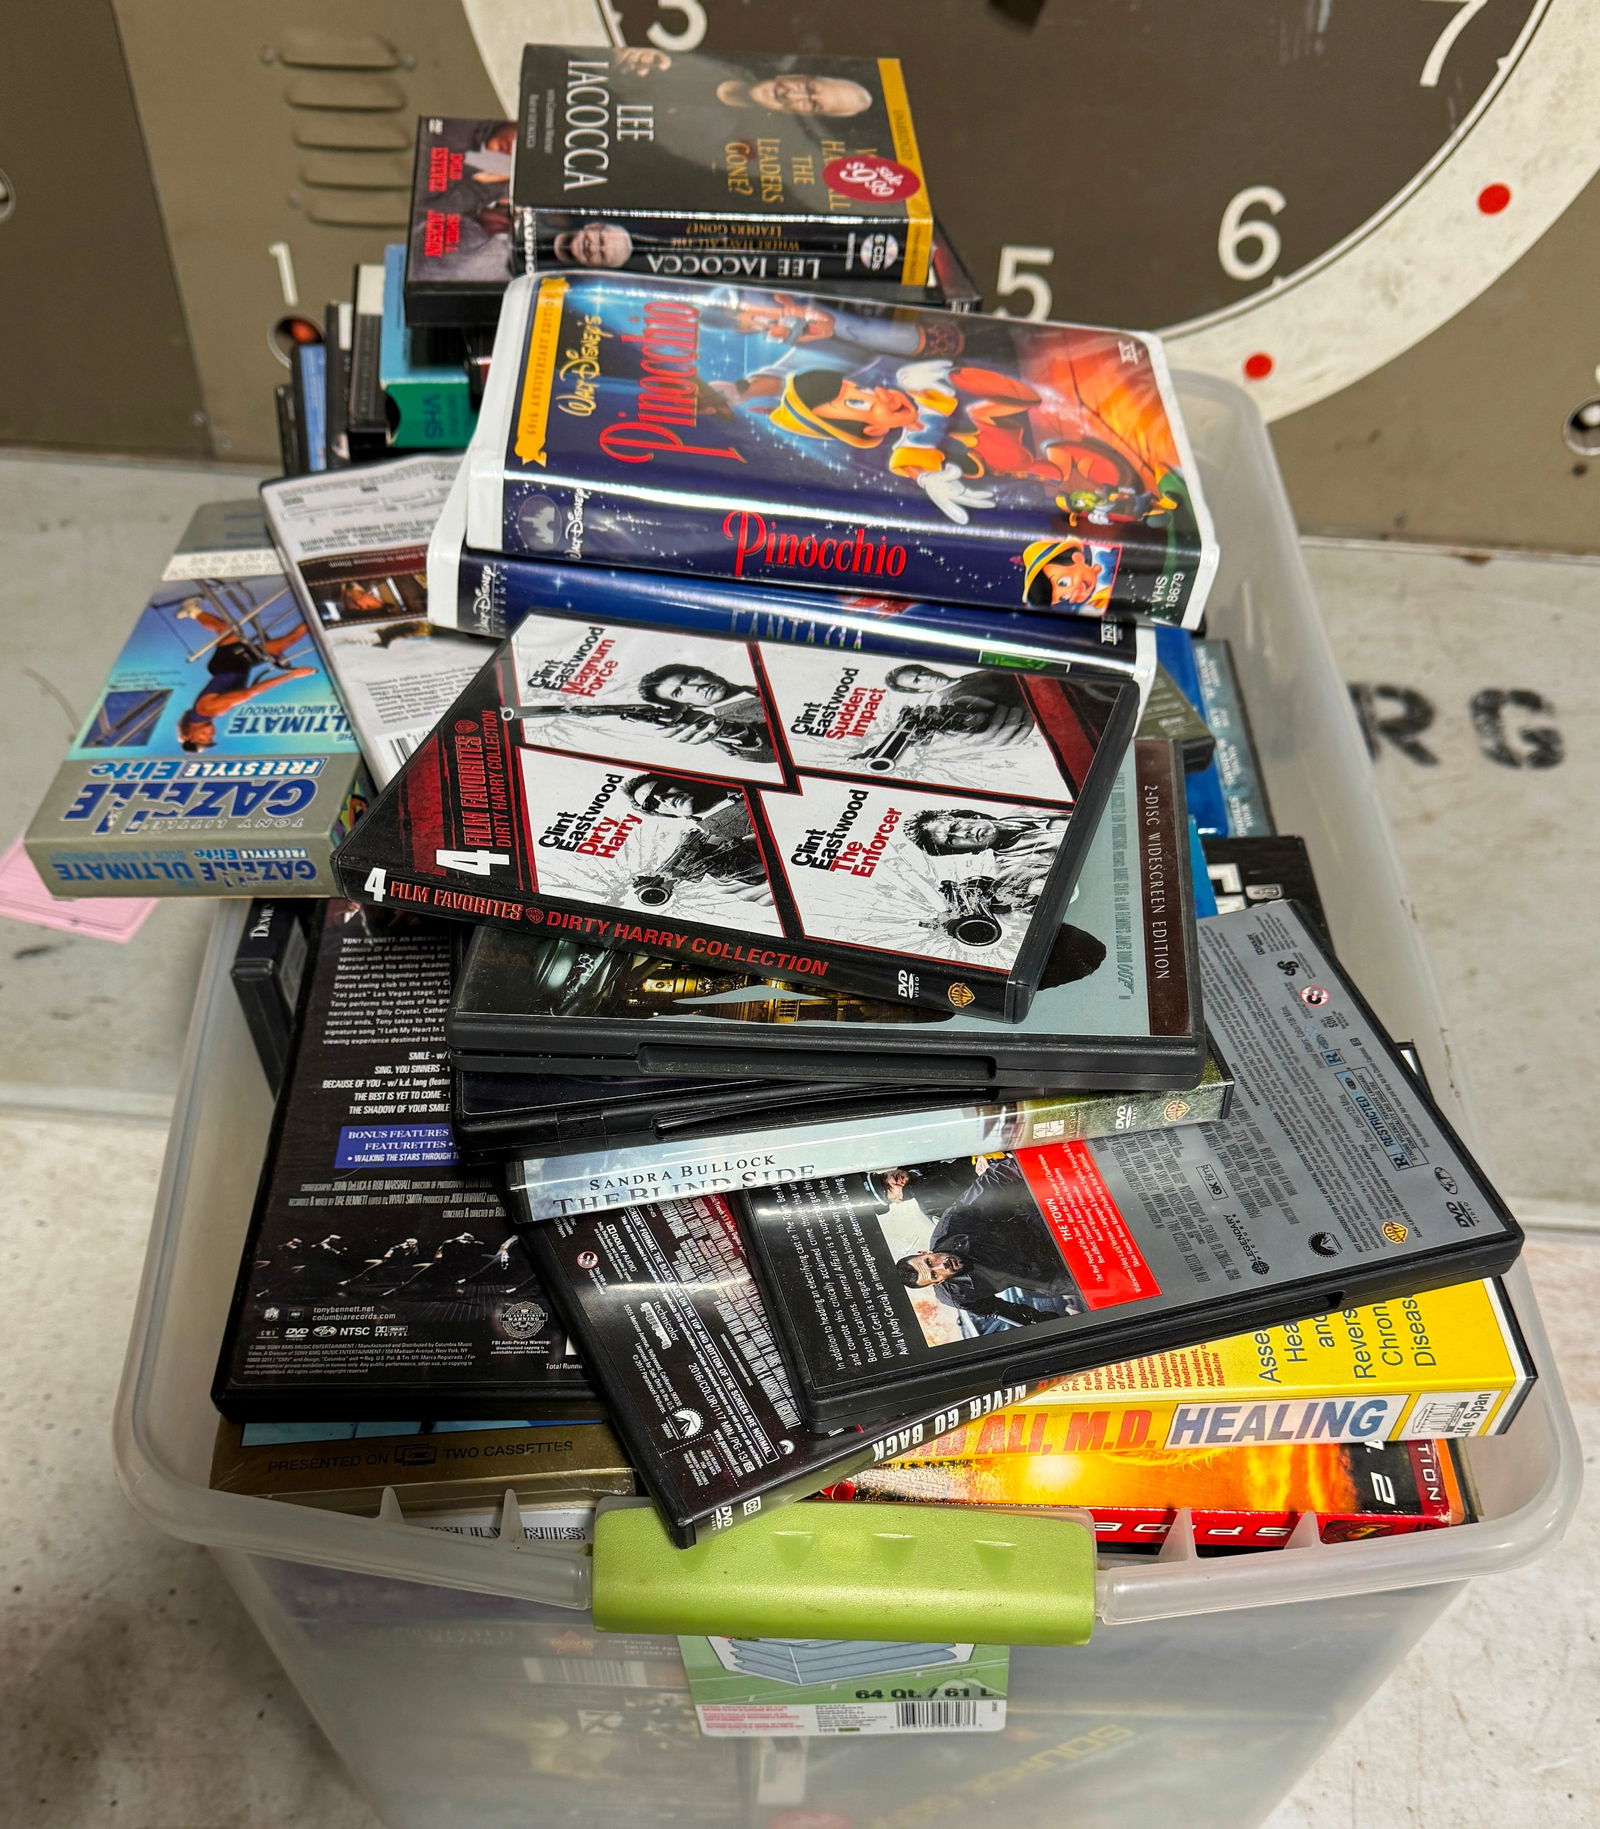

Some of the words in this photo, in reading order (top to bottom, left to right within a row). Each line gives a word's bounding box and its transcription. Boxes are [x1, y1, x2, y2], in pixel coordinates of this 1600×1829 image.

[1420, 0, 1487, 87] 7
[564, 61, 610, 191] IACOCCA
[616, 105, 654, 141] LEE
[429, 147, 448, 192] ESTEVEZ
[724, 142, 754, 197] GONE?
[757, 138, 784, 204] LEADERS
[791, 155, 815, 185] THE
[1218, 186, 1286, 281] 6
[647, 253, 767, 279] IACOCCA
[778, 257, 820, 280] LEE
[997, 246, 1054, 320] 5
[530, 344, 549, 409] ANNIVERSARY
[599, 301, 747, 464] Pinocchio
[722, 510, 907, 578] Pinocchio
[1150, 575, 1169, 604] VHS
[1165, 572, 1185, 609] 18679
[527, 660, 563, 689] Clint
[543, 626, 606, 692] Eastwood
[560, 638, 616, 697] Magnum
[579, 660, 619, 698] Force
[240, 705, 296, 717] WORKOUT
[297, 706, 327, 716] MIND
[790, 702, 823, 736] Clint
[807, 667, 860, 738] Eastwood
[825, 687, 869, 740] Sudden
[847, 688, 887, 738] Impact
[482, 709, 502, 772] COLLECTION
[91, 761, 183, 781] Elite
[184, 760, 320, 777] FREESTYLE
[455, 735, 490, 808] FAVORITES
[65, 778, 317, 834] GAZELLE
[489, 776, 511, 812] HARRY
[1145, 785, 1159, 825] 2-DISC
[238, 818, 305, 829] TONY
[462, 811, 494, 847] FILM
[493, 812, 512, 848] DIRTY
[538, 811, 579, 849] Clint
[556, 773, 625, 853] Eastwood
[810, 789, 869, 871] Eastwood
[240, 848, 307, 860] FREESTYLE
[575, 816, 620, 857] Dirty
[596, 813, 643, 860] Harry
[790, 828, 828, 867] Clint
[851, 807, 902, 878] Enforcer
[52, 860, 194, 882] ULTIMATE
[199, 859, 317, 884] GAZELLE
[436, 849, 510, 876] 4
[829, 840, 863, 873] The
[1148, 831, 1166, 915] WIDESCREEN
[364, 867, 387, 903] 4
[390, 880, 430, 905] FILM
[433, 889, 523, 922] FAVORITES
[546, 910, 613, 936] DIRTY
[613, 923, 688, 952] HARRY
[691, 937, 830, 977] COLLECTION
[1152, 920, 1170, 980] EDITION
[898, 969, 908, 998] DVD
[322, 1079, 355, 1089] BECAUSE
[366, 1078, 381, 1088] YOU
[369, 1092, 388, 1101] BEST
[421, 1090, 442, 1100] COME
[363, 1105, 396, 1115] SHADOW
[408, 1104, 428, 1114] YOUR
[428, 1104, 449, 1113] SMILE
[1116, 1105, 1127, 1129] DVD
[1355, 1095, 1395, 1149] RESTRICTED
[348, 1130, 389, 1140] BONUS
[390, 1128, 449, 1139] FEATURES
[364, 1140, 447, 1151] FEATURETTES
[355, 1153, 385, 1163] WALKING
[399, 1152, 420, 1162] STARS
[421, 1152, 451, 1162] THROUGH
[590, 1170, 672, 1191] SANDRA
[681, 1154, 777, 1178] BULLOCK
[553, 1192, 620, 1216] THE
[1046, 1198, 1068, 1223] TOWN
[1061, 1224, 1073, 1242] THE
[800, 1255, 816, 1290] electrifying
[814, 1249, 831, 1280] acclaimed
[829, 1250, 845, 1272] Affairs
[862, 1245, 878, 1285] investigator,
[825, 1281, 839, 1308] critically
[840, 1274, 853, 1300] Internal
[312, 1311, 396, 1321] columbiarecords.com
[313, 1304, 375, 1315] tonybennett.net
[653, 1302, 679, 1342] technicolor
[815, 1299, 829, 1325] heading
[339, 1326, 370, 1336] NTSC
[829, 1334, 843, 1362] addition
[842, 1326, 857, 1351] cowrote
[876, 1332, 895, 1361] (Richard
[896, 1338, 909, 1357] Avila
[1283, 1322, 1308, 1363] Hea
[1342, 1308, 1377, 1379] Revers
[1372, 1304, 1403, 1367] Chron
[1402, 1298, 1437, 1367] Diseas
[862, 1339, 877, 1364] Boston
[1255, 1330, 1282, 1384] Asse
[703, 1342, 725, 1370] BOTTOM
[730, 1388, 751, 1415] SCREEN
[751, 1426, 775, 1458] NORMAL.
[970, 1384, 1027, 1420] NEVER
[1466, 1393, 1492, 1420] Span
[934, 1408, 960, 1434] GO
[975, 1413, 1054, 1455] ALI,
[1064, 1409, 1157, 1451] M.D.
[1169, 1399, 1388, 1447] HEALING
[268, 1451, 362, 1472] PRESENTED
[366, 1453, 389, 1467] ON
[443, 1447, 478, 1460] TWO
[483, 1440, 574, 1458] CASSETTES
[872, 1424, 923, 1462] BACK
[1371, 1472, 1396, 1505] 2
[1419, 1443, 1441, 1502] TION
[855, 1688, 884, 1700] 64
[926, 1687, 938, 1699] /
[944, 1686, 972, 1698] 61
[980, 1686, 994, 1697] L
